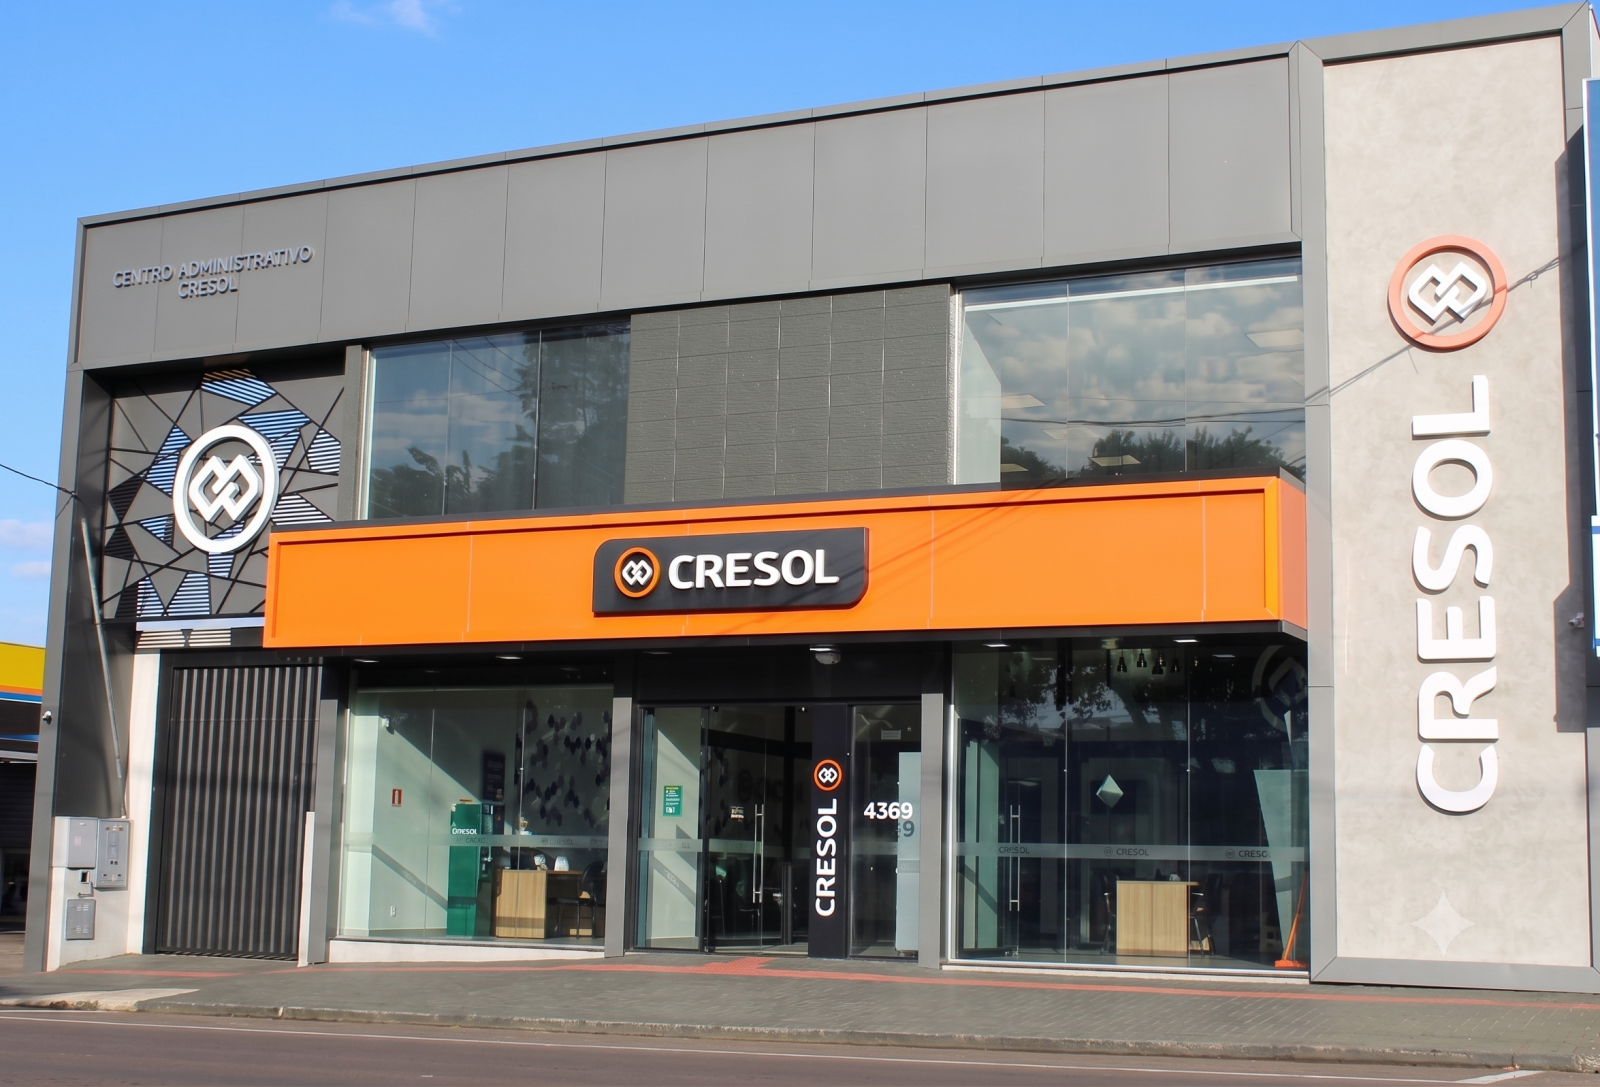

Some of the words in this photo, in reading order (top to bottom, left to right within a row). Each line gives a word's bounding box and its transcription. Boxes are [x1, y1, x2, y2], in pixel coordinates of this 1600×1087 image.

[113, 264, 174, 288] CENTRO
[178, 245, 314, 280] ADMINISTRATIVO
[178, 276, 238, 299] CRESOL
[668, 549, 840, 590] CRESOL
[1411, 374, 1500, 816] CRESOL
[863, 801, 914, 820] 4369
[814, 798, 838, 917] CRESOL
[1116, 848, 1149, 856] CRESOL
[1238, 850, 1271, 858] CRESO
